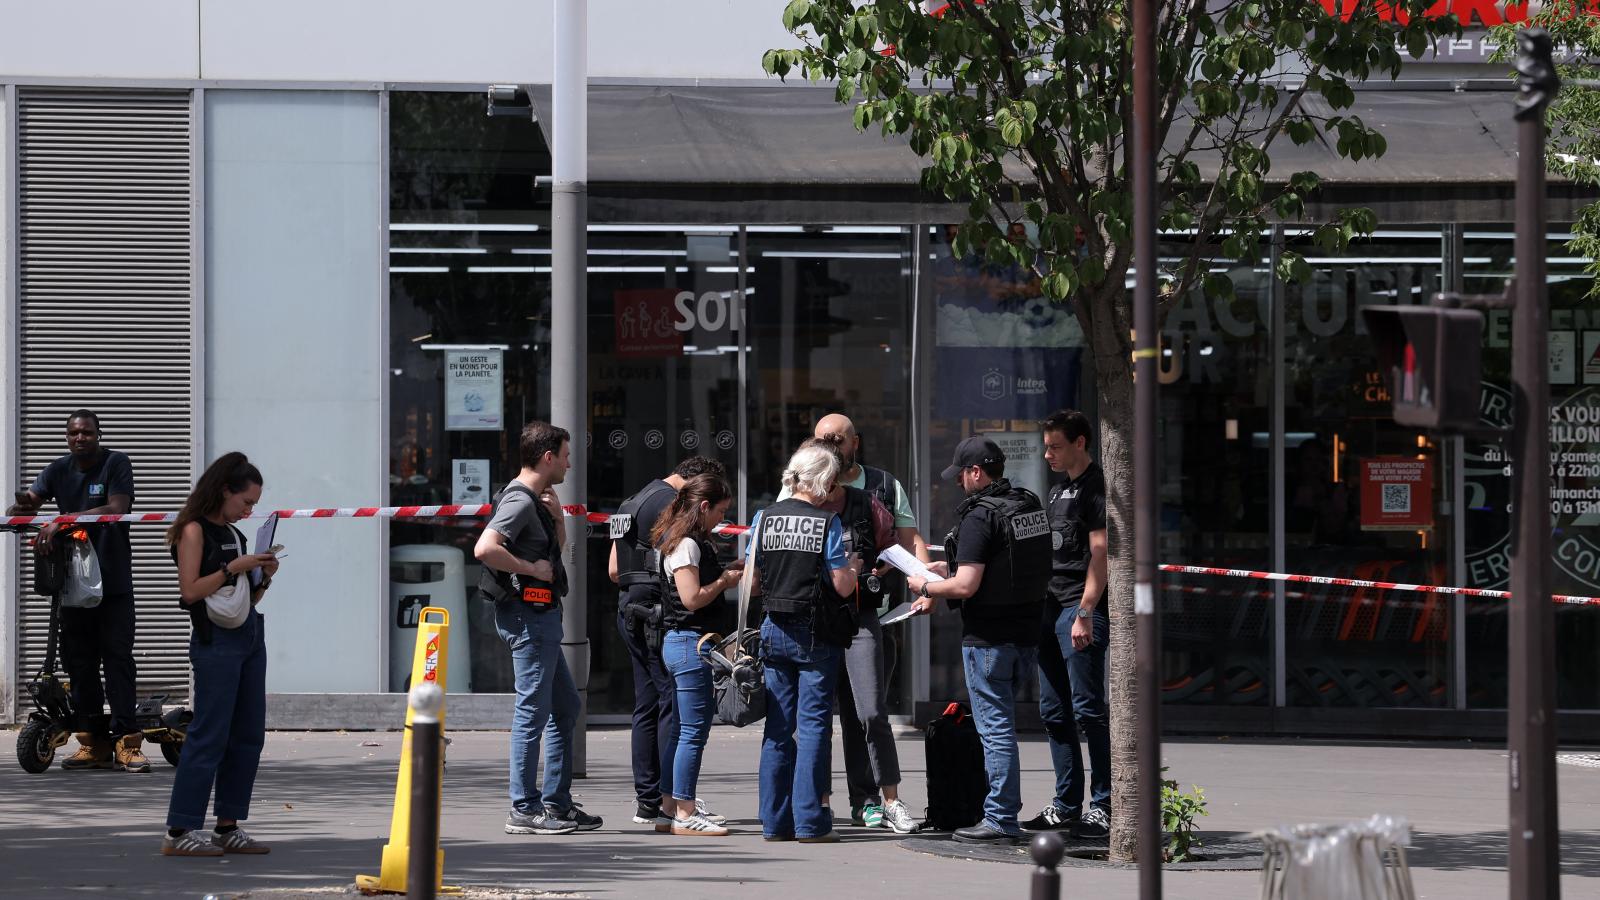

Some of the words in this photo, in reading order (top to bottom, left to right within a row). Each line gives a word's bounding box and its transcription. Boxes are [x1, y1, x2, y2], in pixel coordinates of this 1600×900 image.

[456, 370, 463, 378] LA
[1365, 387, 1391, 402] CH
[1484, 449, 1501, 462] du
[765, 516, 824, 535] POLICE
[1014, 512, 1046, 529] POLICE
[1015, 525, 1049, 538] JUDICIAIRE
[764, 533, 822, 551] JUDICIAIRE
[524, 590, 550, 600] POLIC
[424, 656, 438, 681] GER
